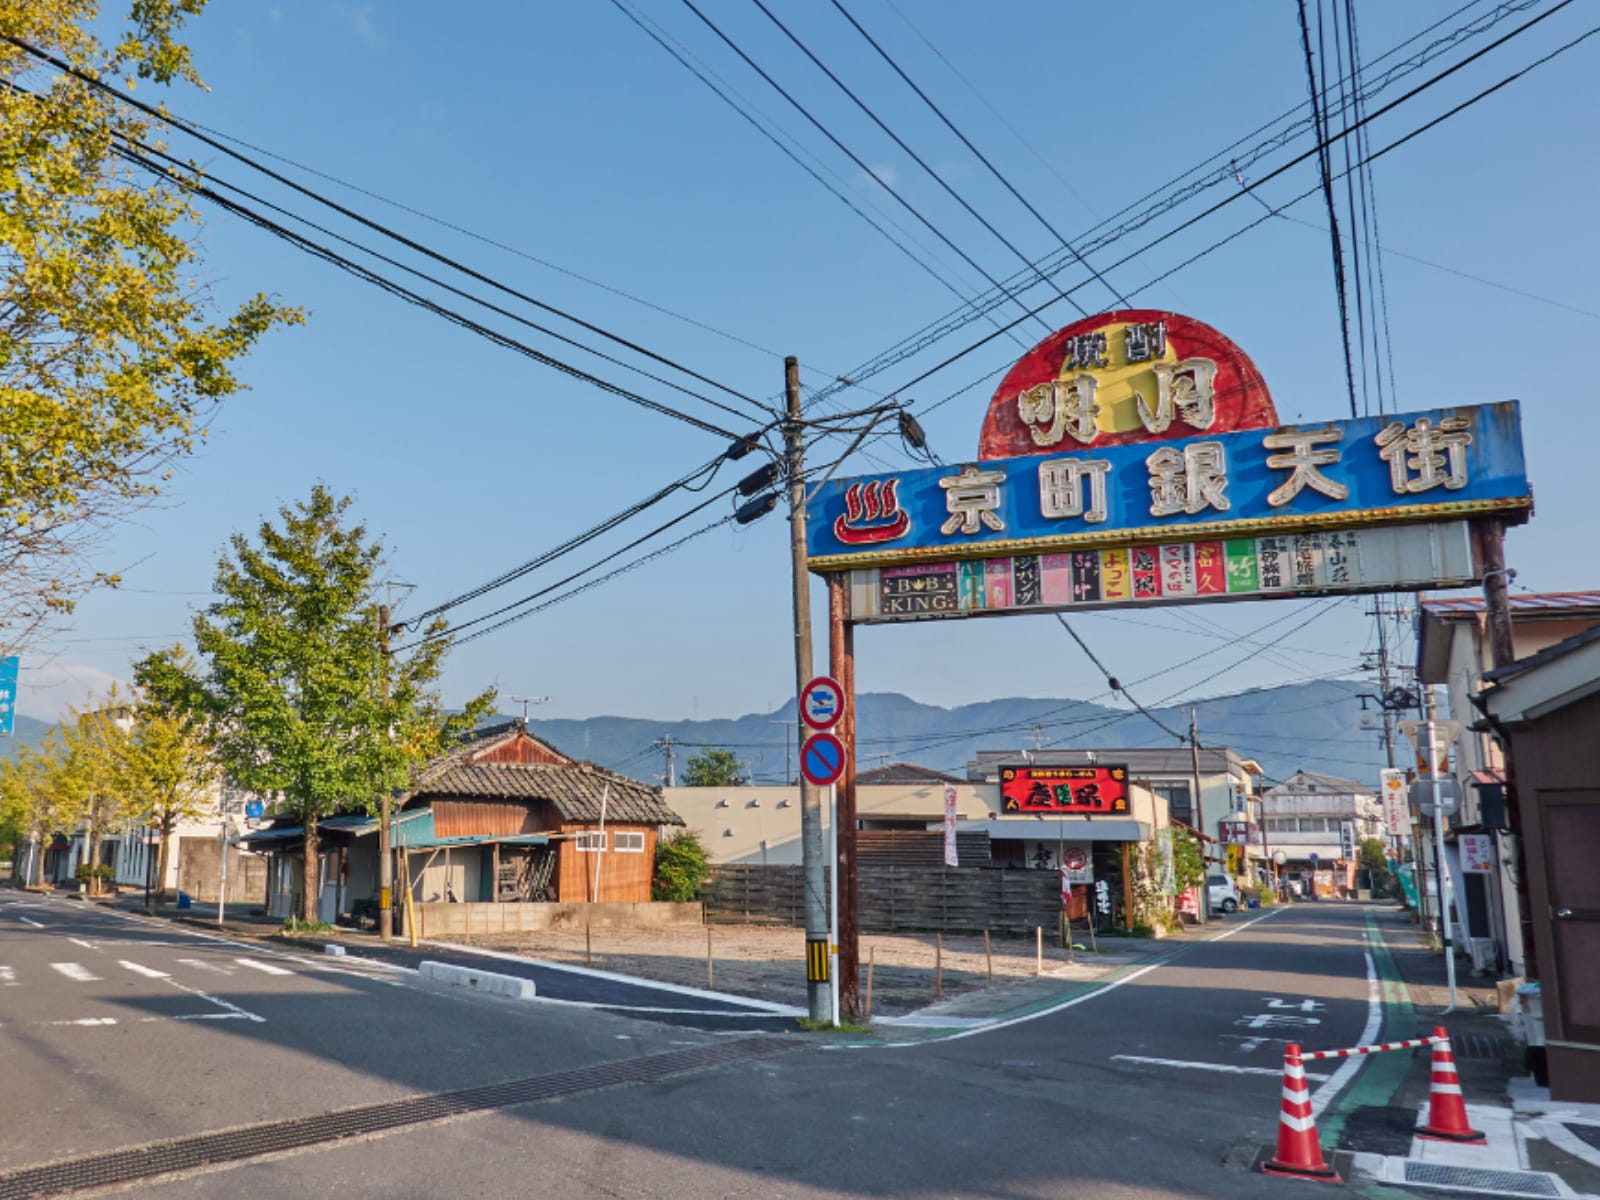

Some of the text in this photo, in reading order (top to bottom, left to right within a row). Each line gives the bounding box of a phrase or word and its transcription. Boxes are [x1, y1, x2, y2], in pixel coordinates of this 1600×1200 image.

[1018, 357, 1218, 447] 明月
[940, 418, 1473, 535] 京町銀天街
[1229, 556, 1256, 578] 竹
[891, 595, 946, 612] KING
